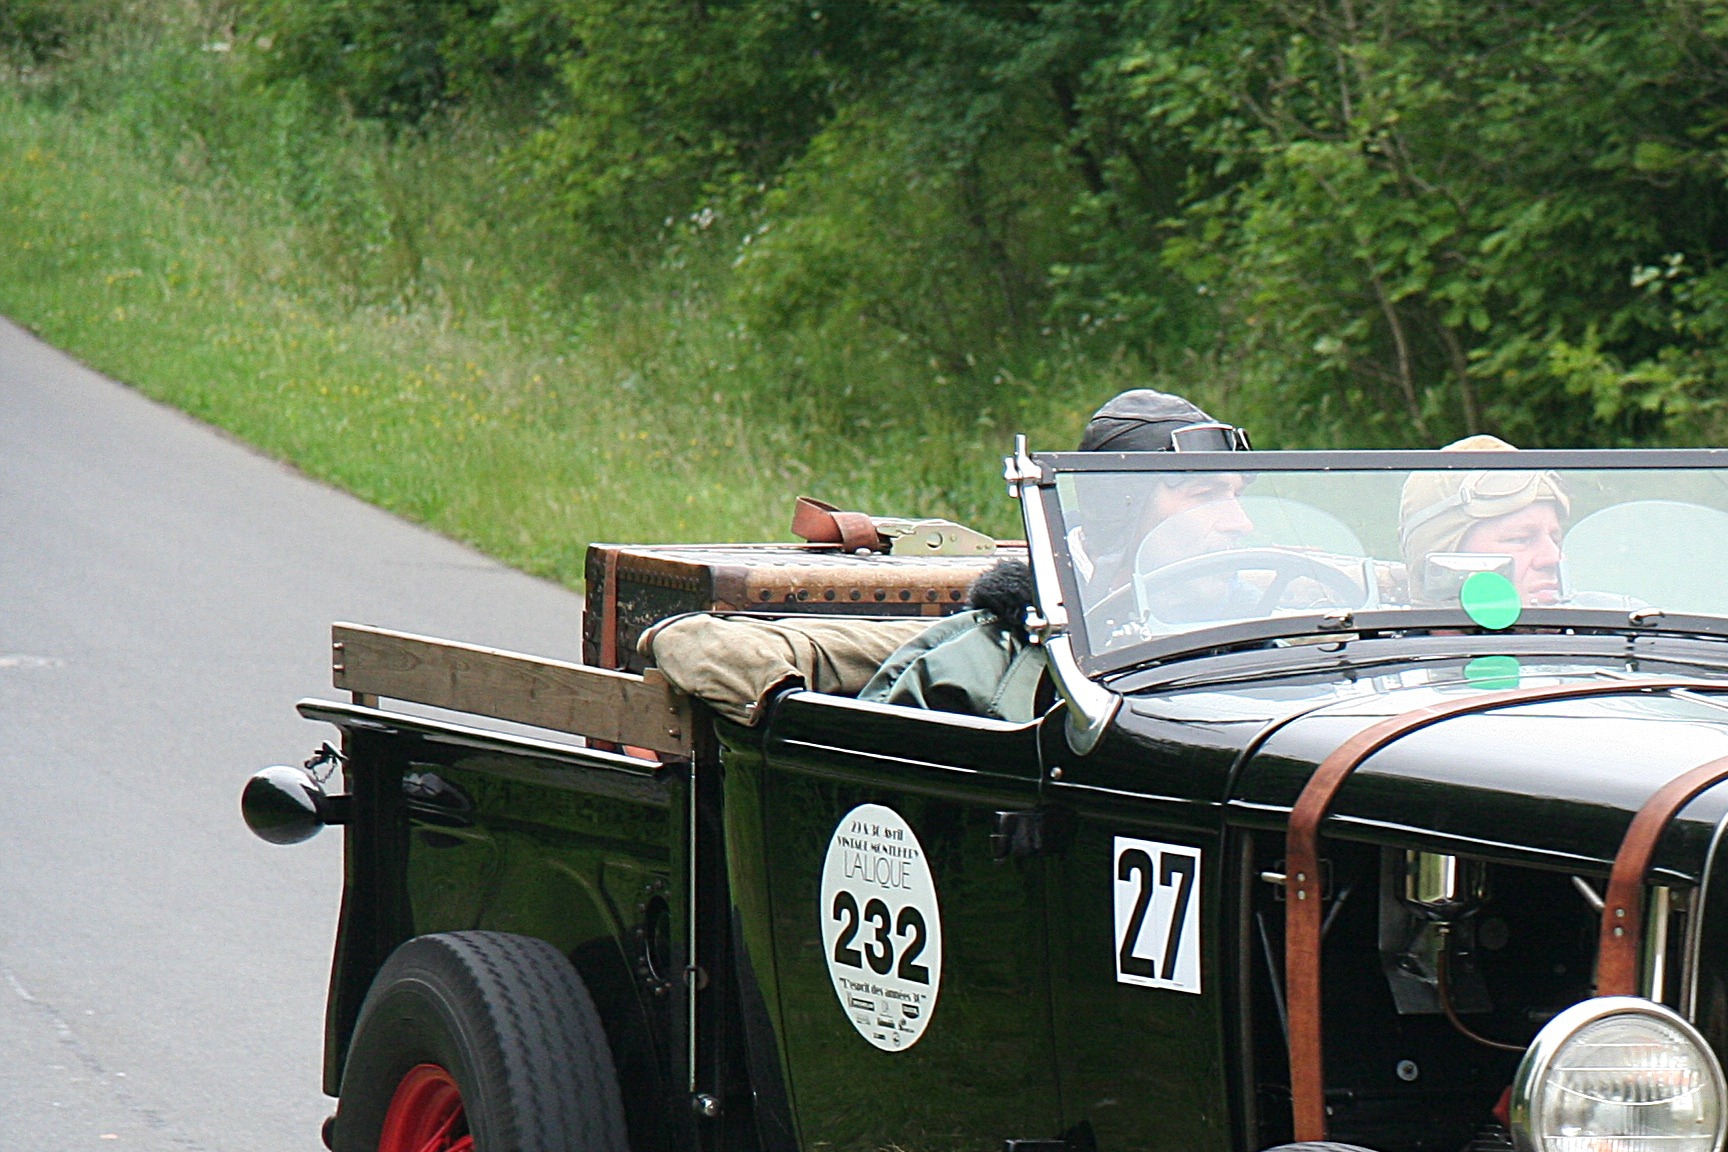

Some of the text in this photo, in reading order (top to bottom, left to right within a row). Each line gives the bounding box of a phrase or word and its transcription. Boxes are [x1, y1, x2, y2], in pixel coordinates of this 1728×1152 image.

[844, 850, 912, 890] LALIQUE
[1118, 847, 1196, 980] 27
[833, 890, 929, 985] 232
